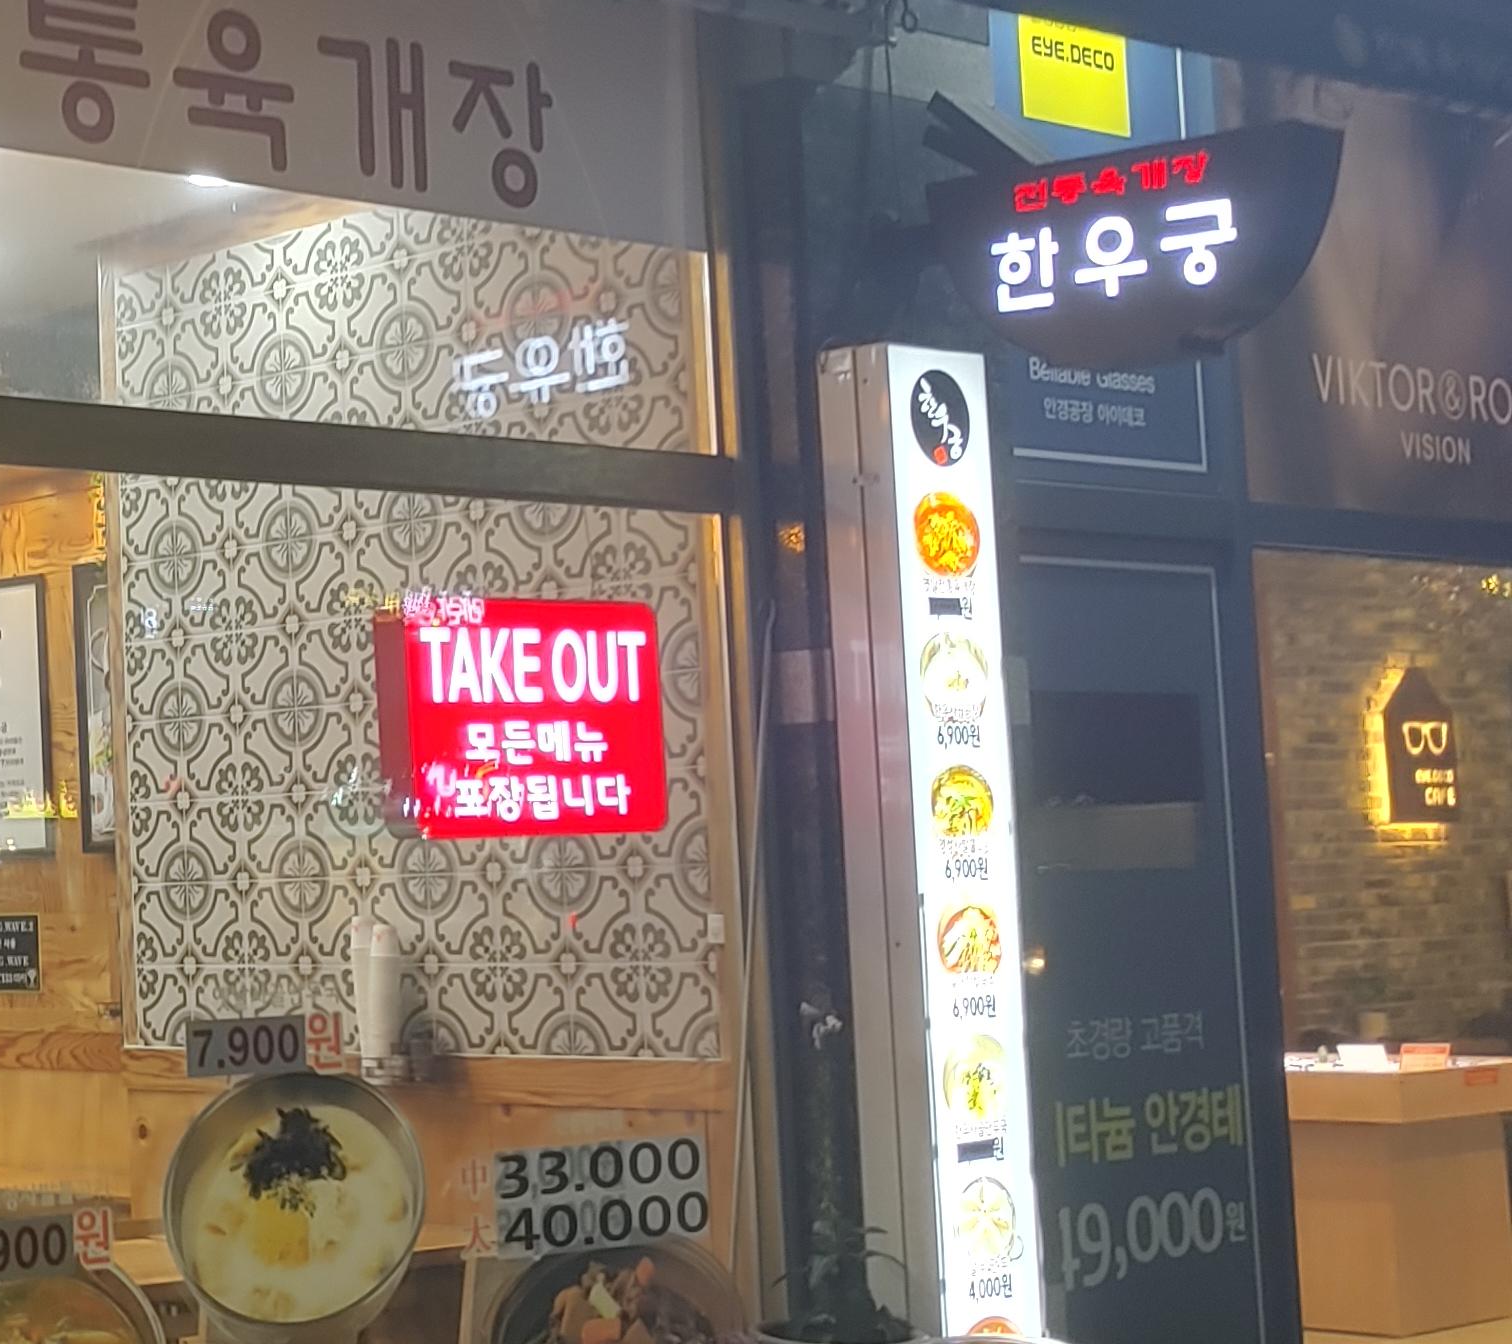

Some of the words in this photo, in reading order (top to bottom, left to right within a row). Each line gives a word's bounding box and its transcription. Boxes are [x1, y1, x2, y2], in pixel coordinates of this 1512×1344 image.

[1031, 36, 1115, 72] EYE.DECO
[990, 198, 1239, 314] 한우궁
[1400, 430, 1471, 465] VISION
[419, 626, 544, 704] TAKE
[551, 629, 647, 703] OUT
[465, 719, 609, 765] 모든메뉴
[454, 773, 631, 822] 포장됩니다
[1066, 1016, 1133, 1061] 초경량
[1140, 1010, 1205, 1053] 고품격
[1144, 1083, 1244, 1155] 안경테
[504, 1190, 709, 1251] 40.000
